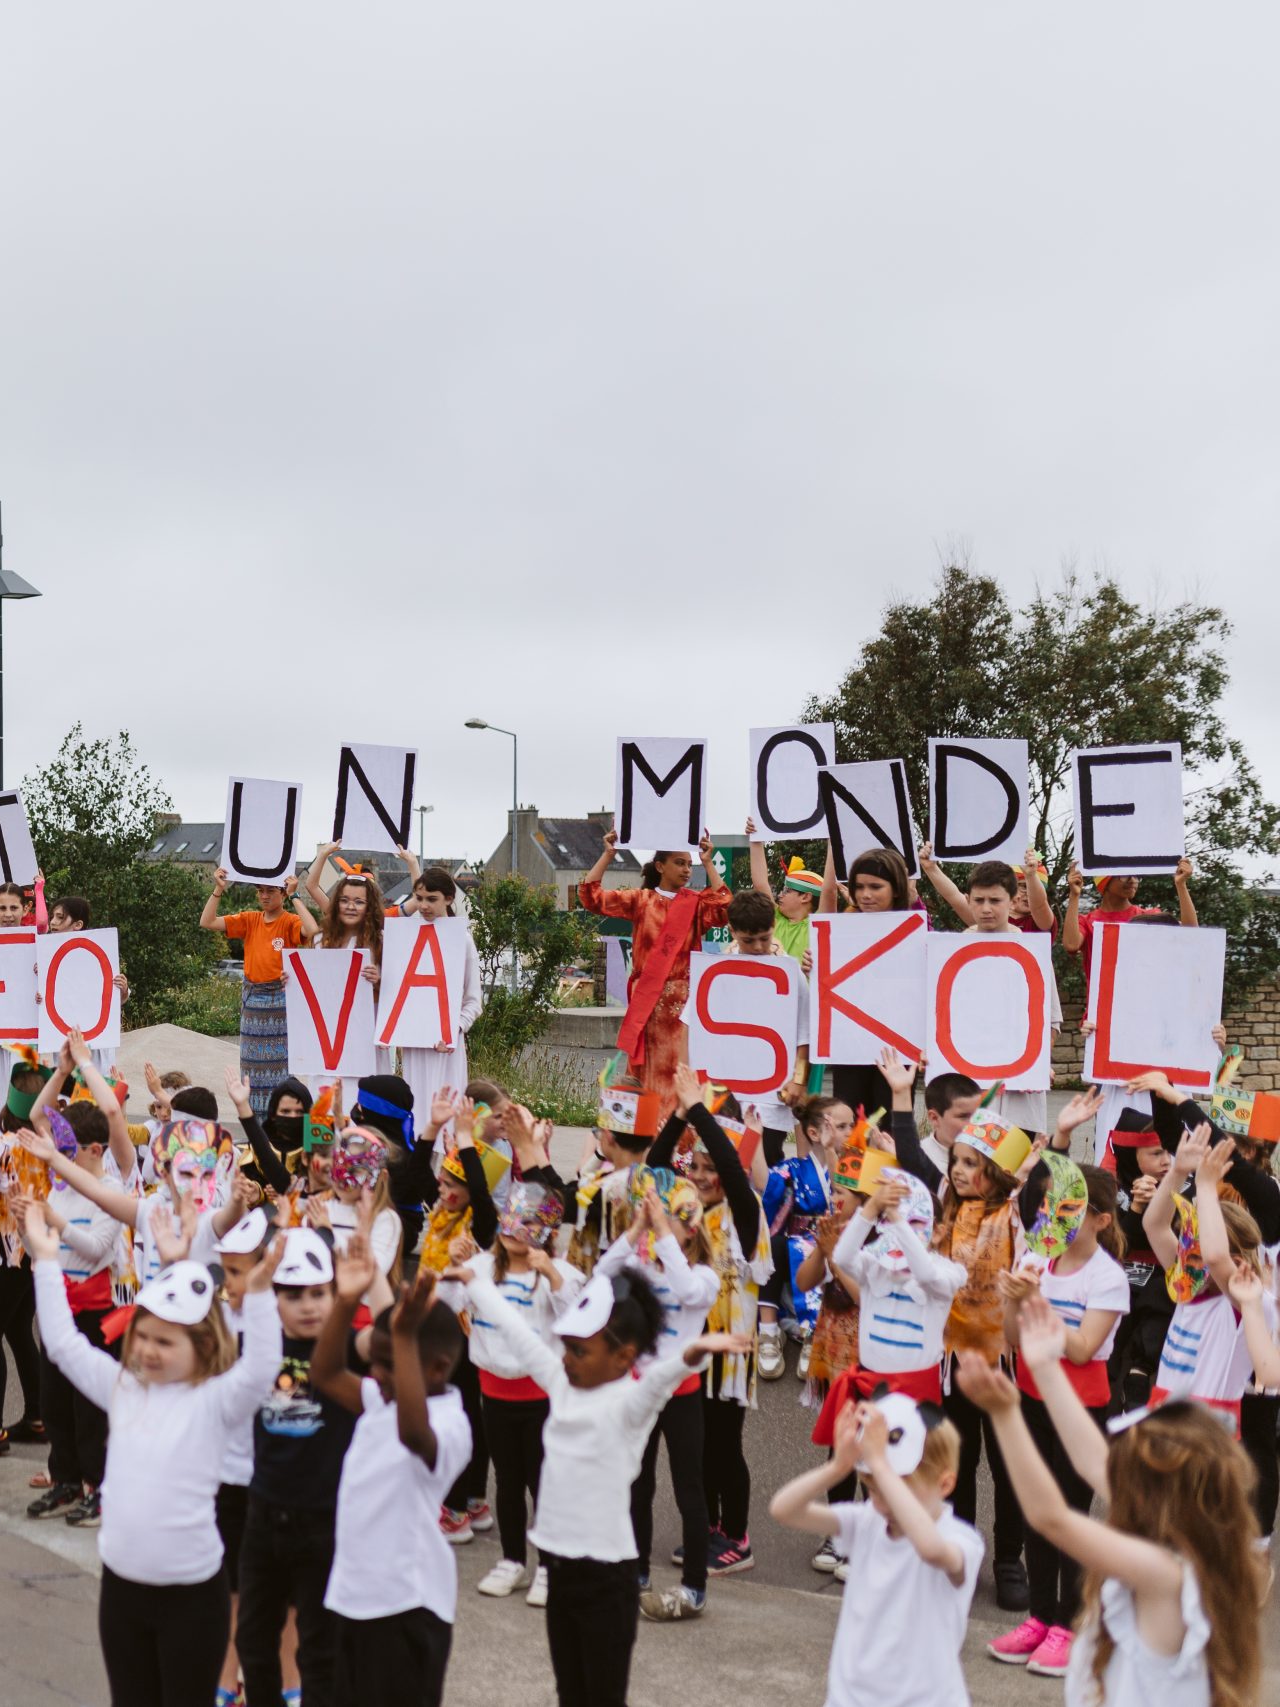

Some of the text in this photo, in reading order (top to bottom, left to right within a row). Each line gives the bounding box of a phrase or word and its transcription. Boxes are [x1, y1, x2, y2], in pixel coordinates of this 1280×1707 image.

[229, 747, 416, 878] UN
[620, 730, 1183, 882] MONDE
[289, 925, 453, 1071] VA
[696, 914, 1211, 1093] SKOL
